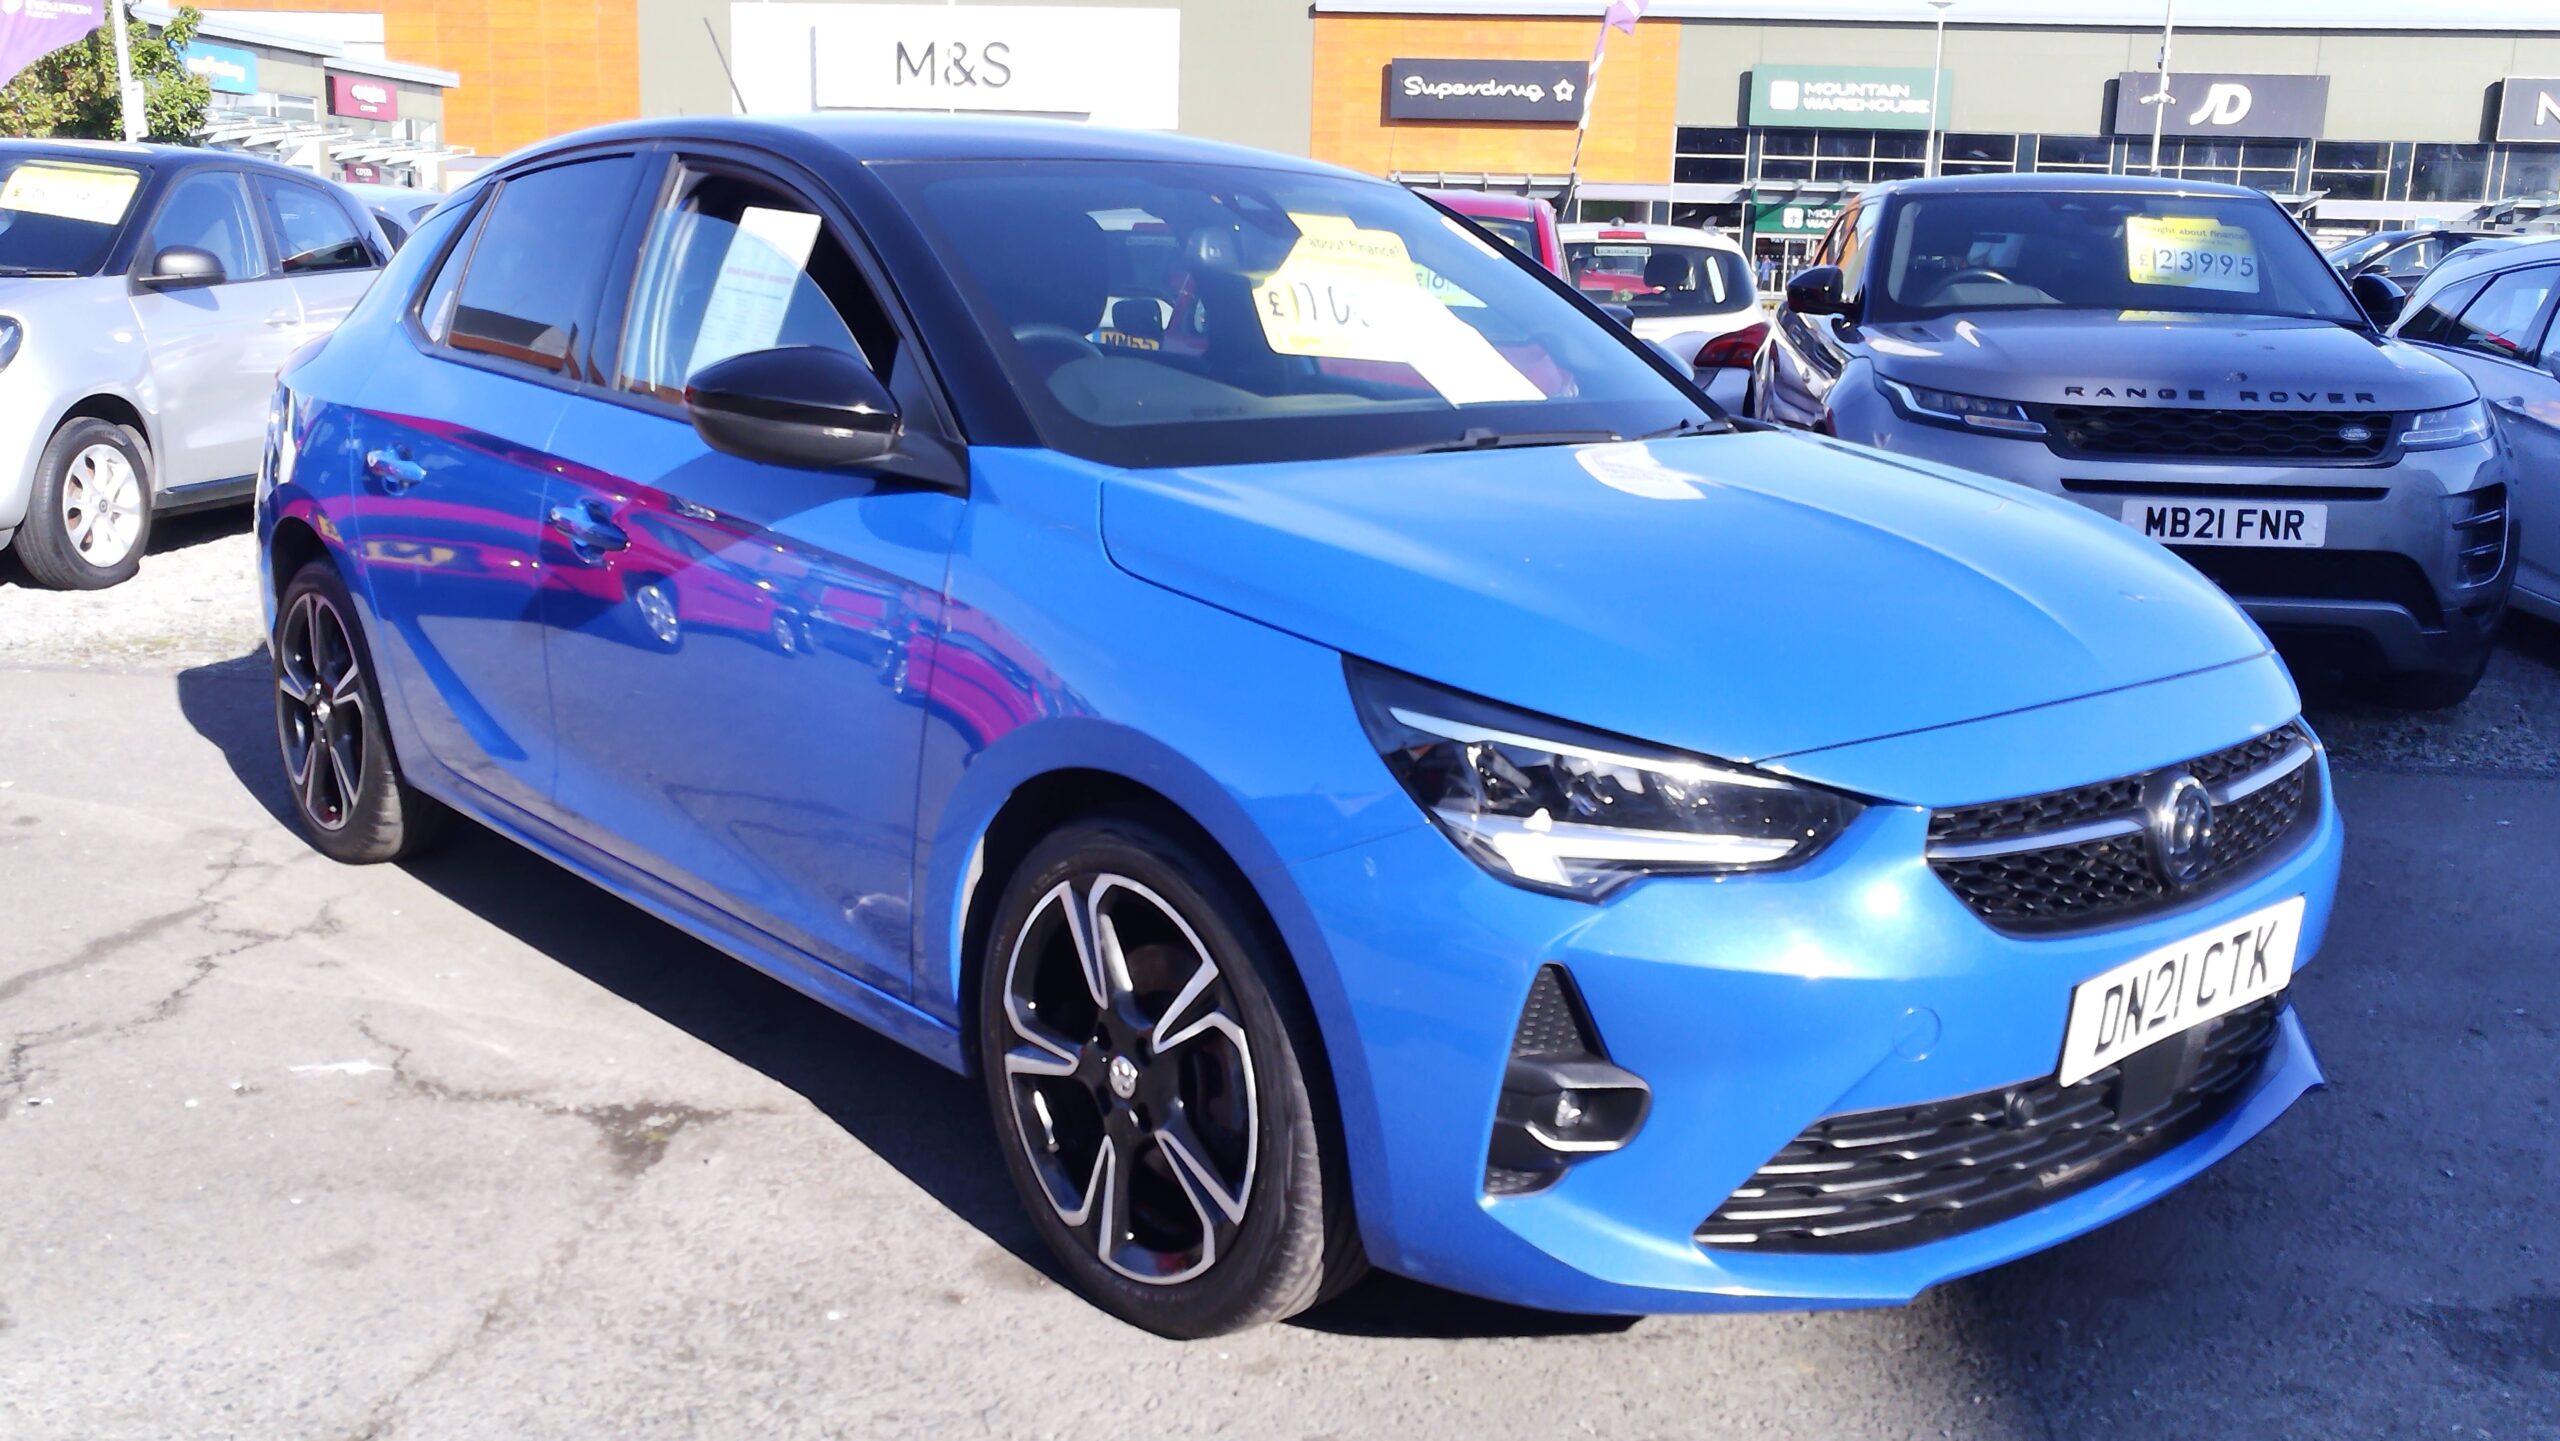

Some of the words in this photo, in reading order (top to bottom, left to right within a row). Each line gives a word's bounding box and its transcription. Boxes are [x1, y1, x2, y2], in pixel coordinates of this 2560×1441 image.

[896, 41, 1011, 88] M&S
[1404, 75, 1545, 103] Superdrug
[1804, 82, 1910, 97] MOUNTAIN
[2189, 83, 2252, 126] JD
[1803, 97, 1930, 113] WAREHOUSE
[2064, 386, 2206, 401] RANGE
[2239, 390, 2377, 404] ROVER
[2145, 506, 2225, 539] MB21
[2236, 508, 2305, 541] FNR
[2094, 953, 2189, 1056] DN21
[2196, 920, 2278, 1008] CTK
